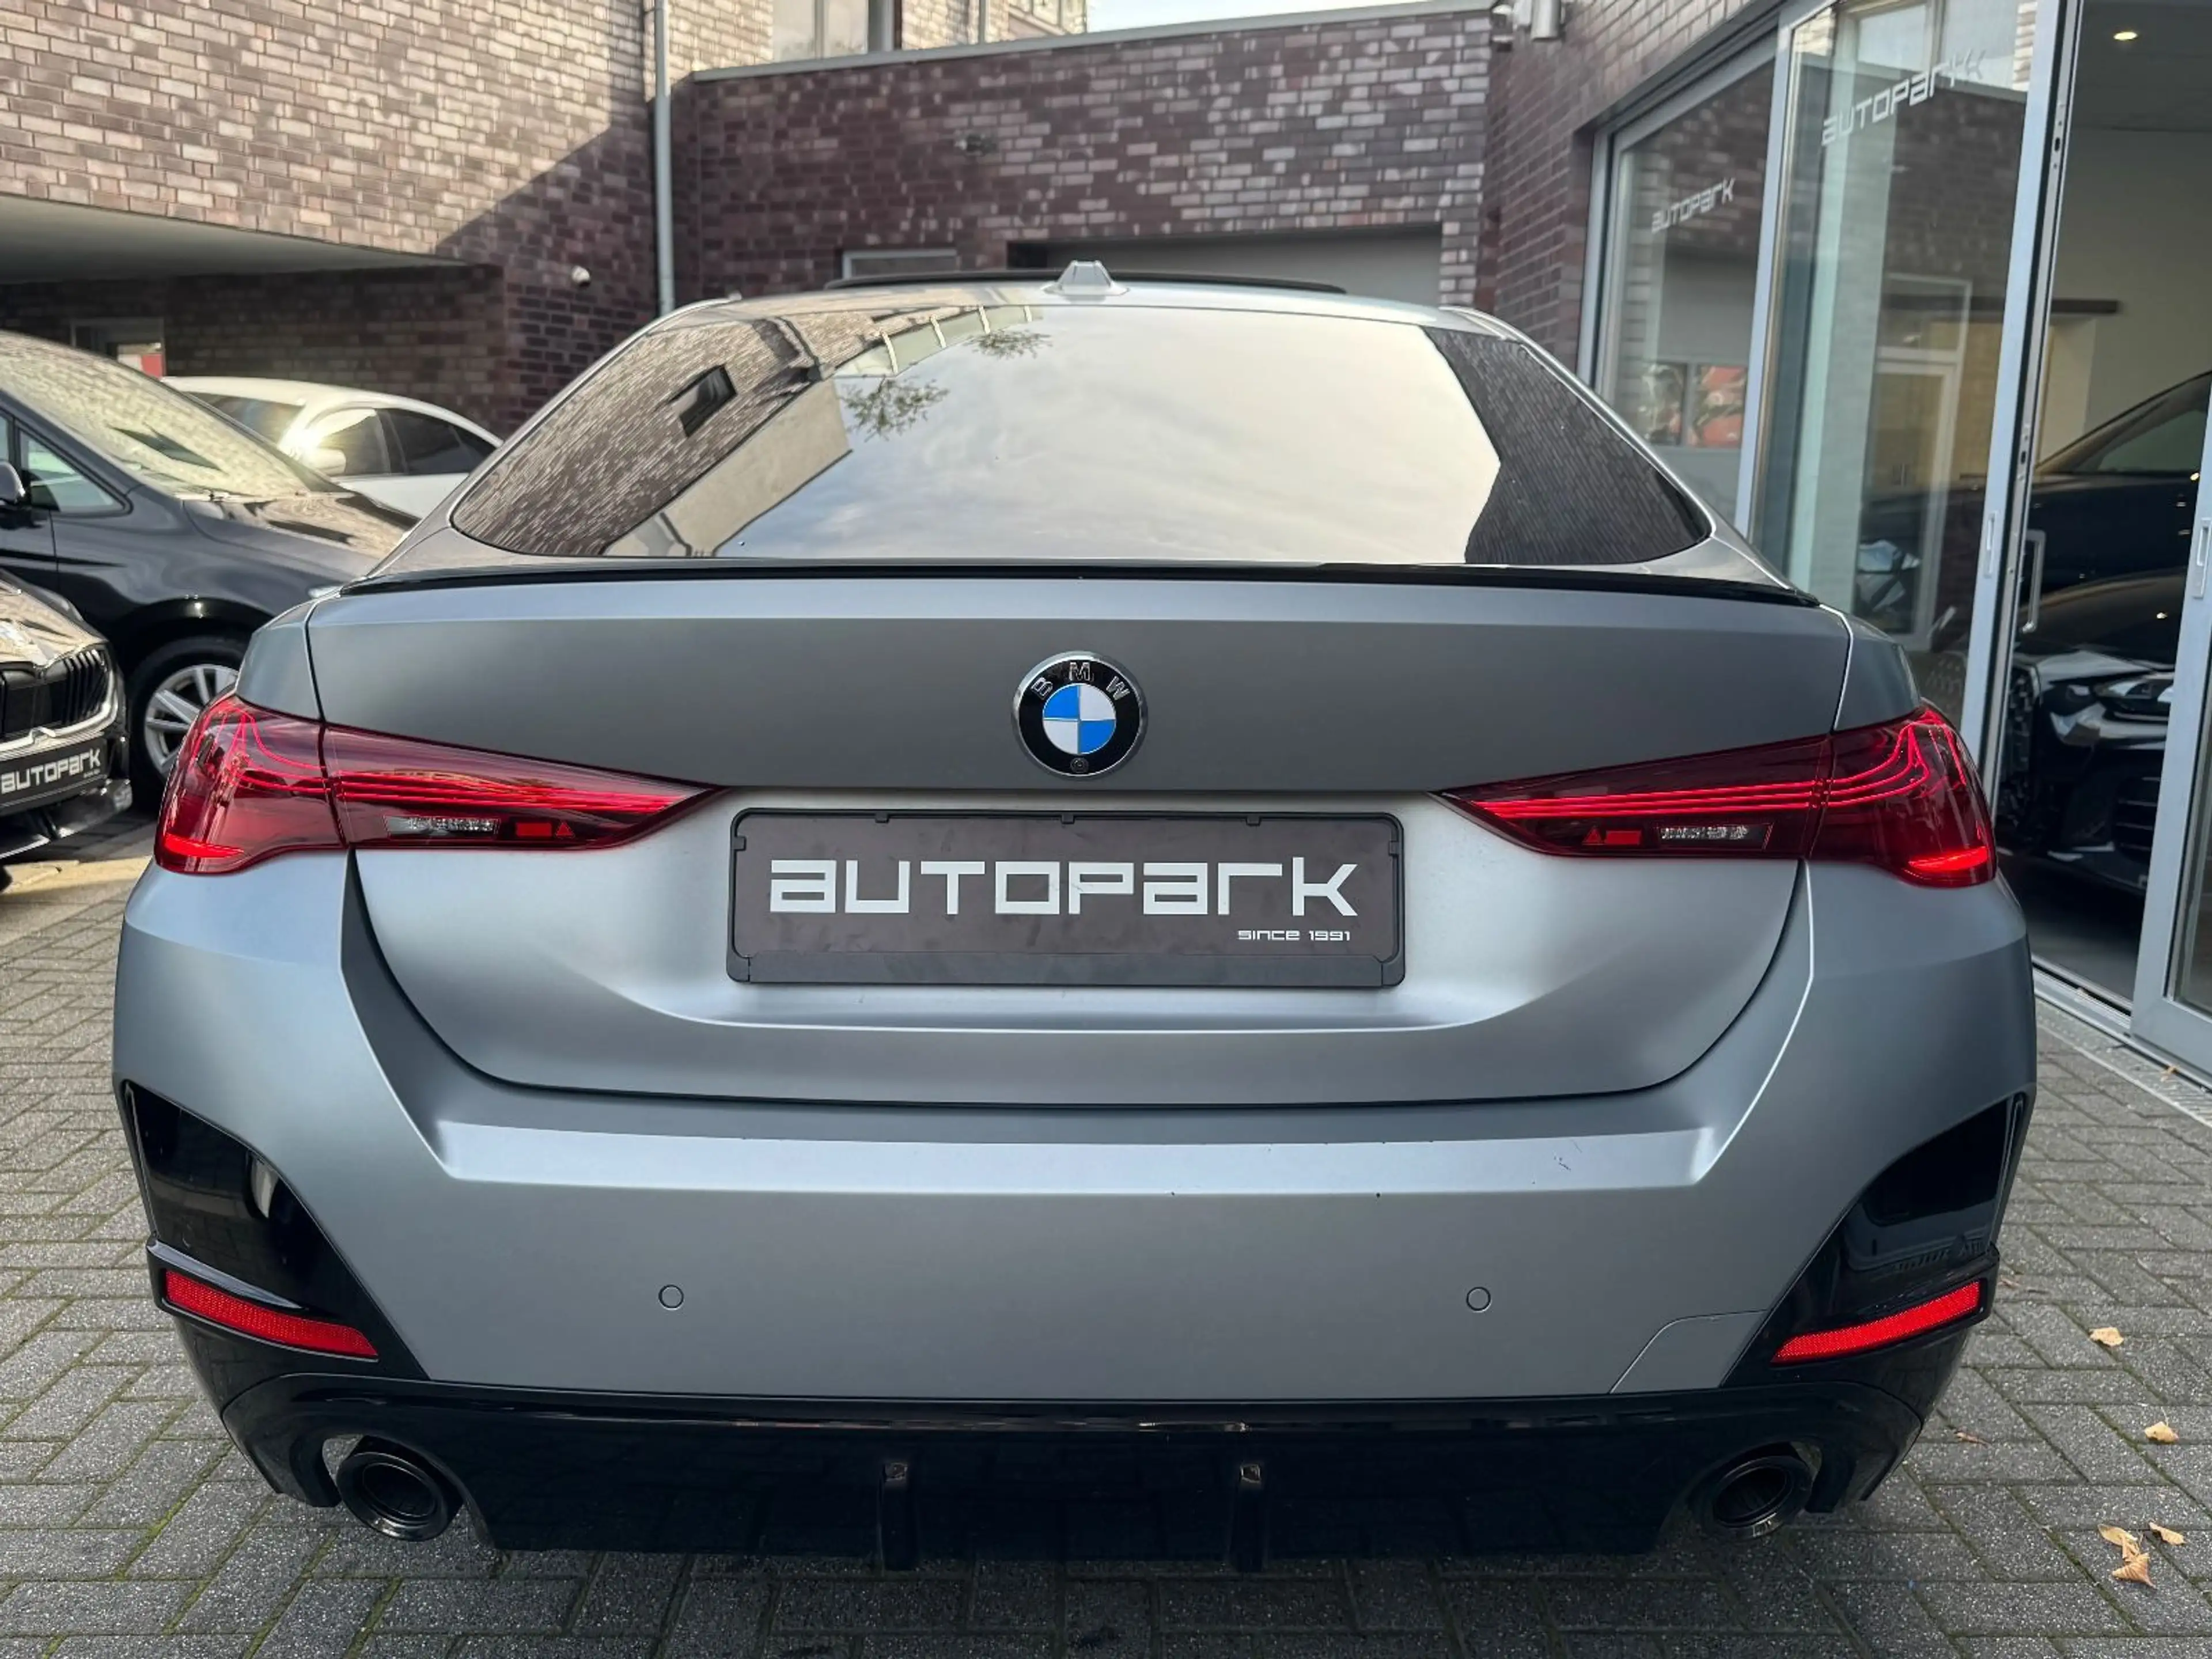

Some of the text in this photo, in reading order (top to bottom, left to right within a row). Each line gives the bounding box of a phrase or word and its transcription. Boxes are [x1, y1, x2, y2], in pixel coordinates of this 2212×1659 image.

[1031, 662, 1130, 700] BMW
[1238, 930, 1351, 941] since 1991
